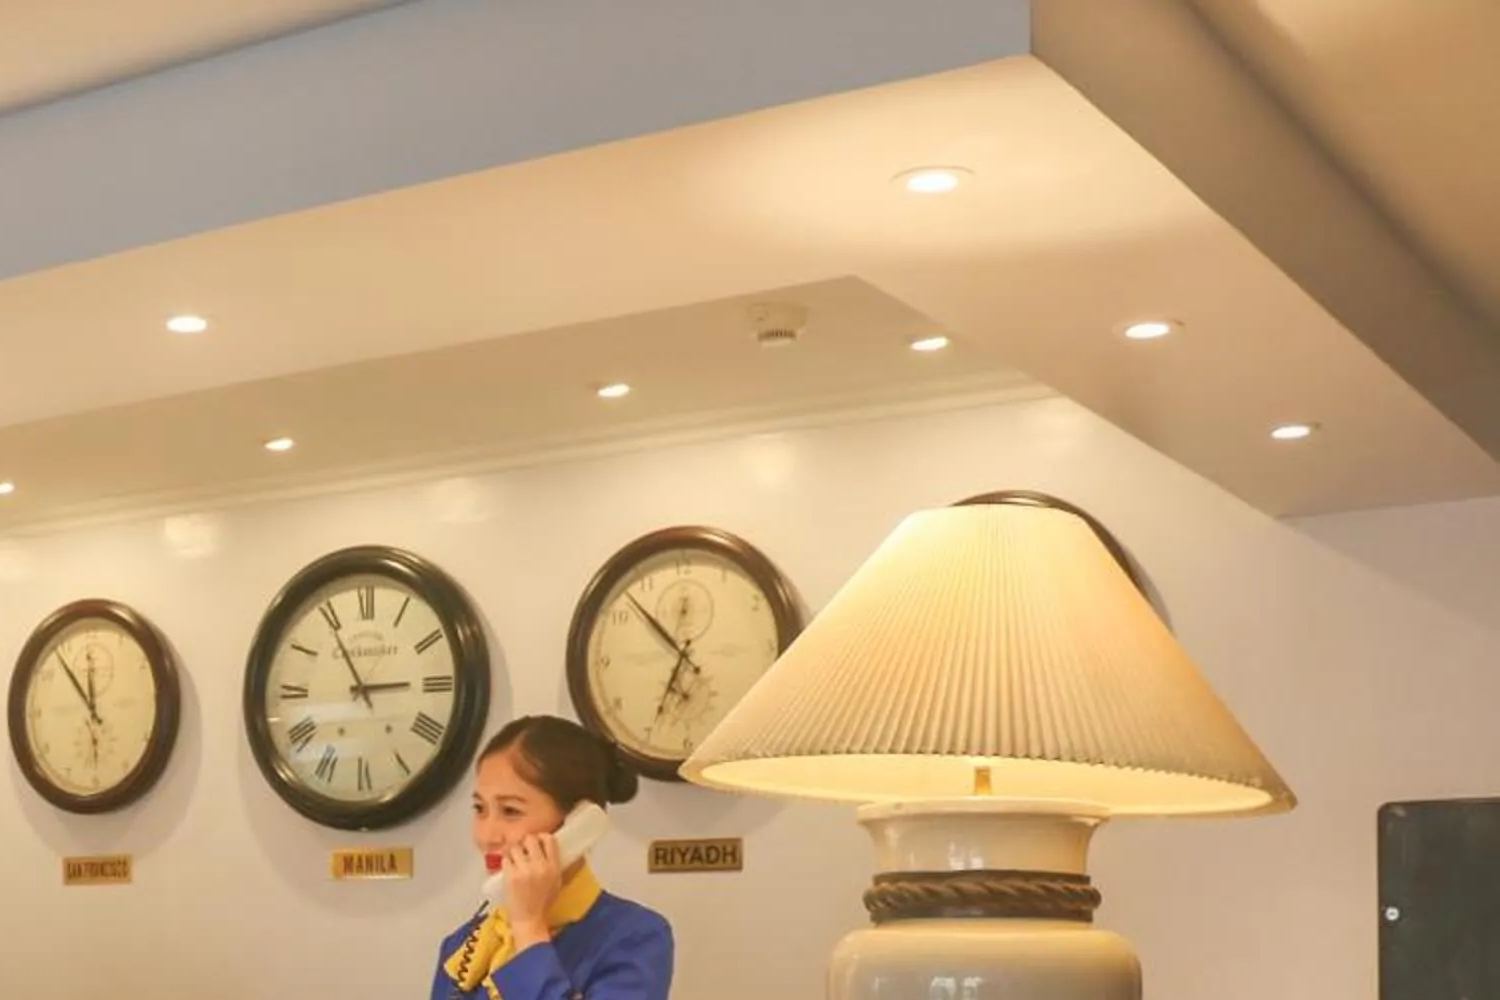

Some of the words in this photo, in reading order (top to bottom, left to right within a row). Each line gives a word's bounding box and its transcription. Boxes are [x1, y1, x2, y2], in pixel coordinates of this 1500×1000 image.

[414, 628, 444, 655] II
[422, 675, 453, 693] III
[343, 853, 399, 874] MANILA
[654, 845, 738, 865] RIYADH
